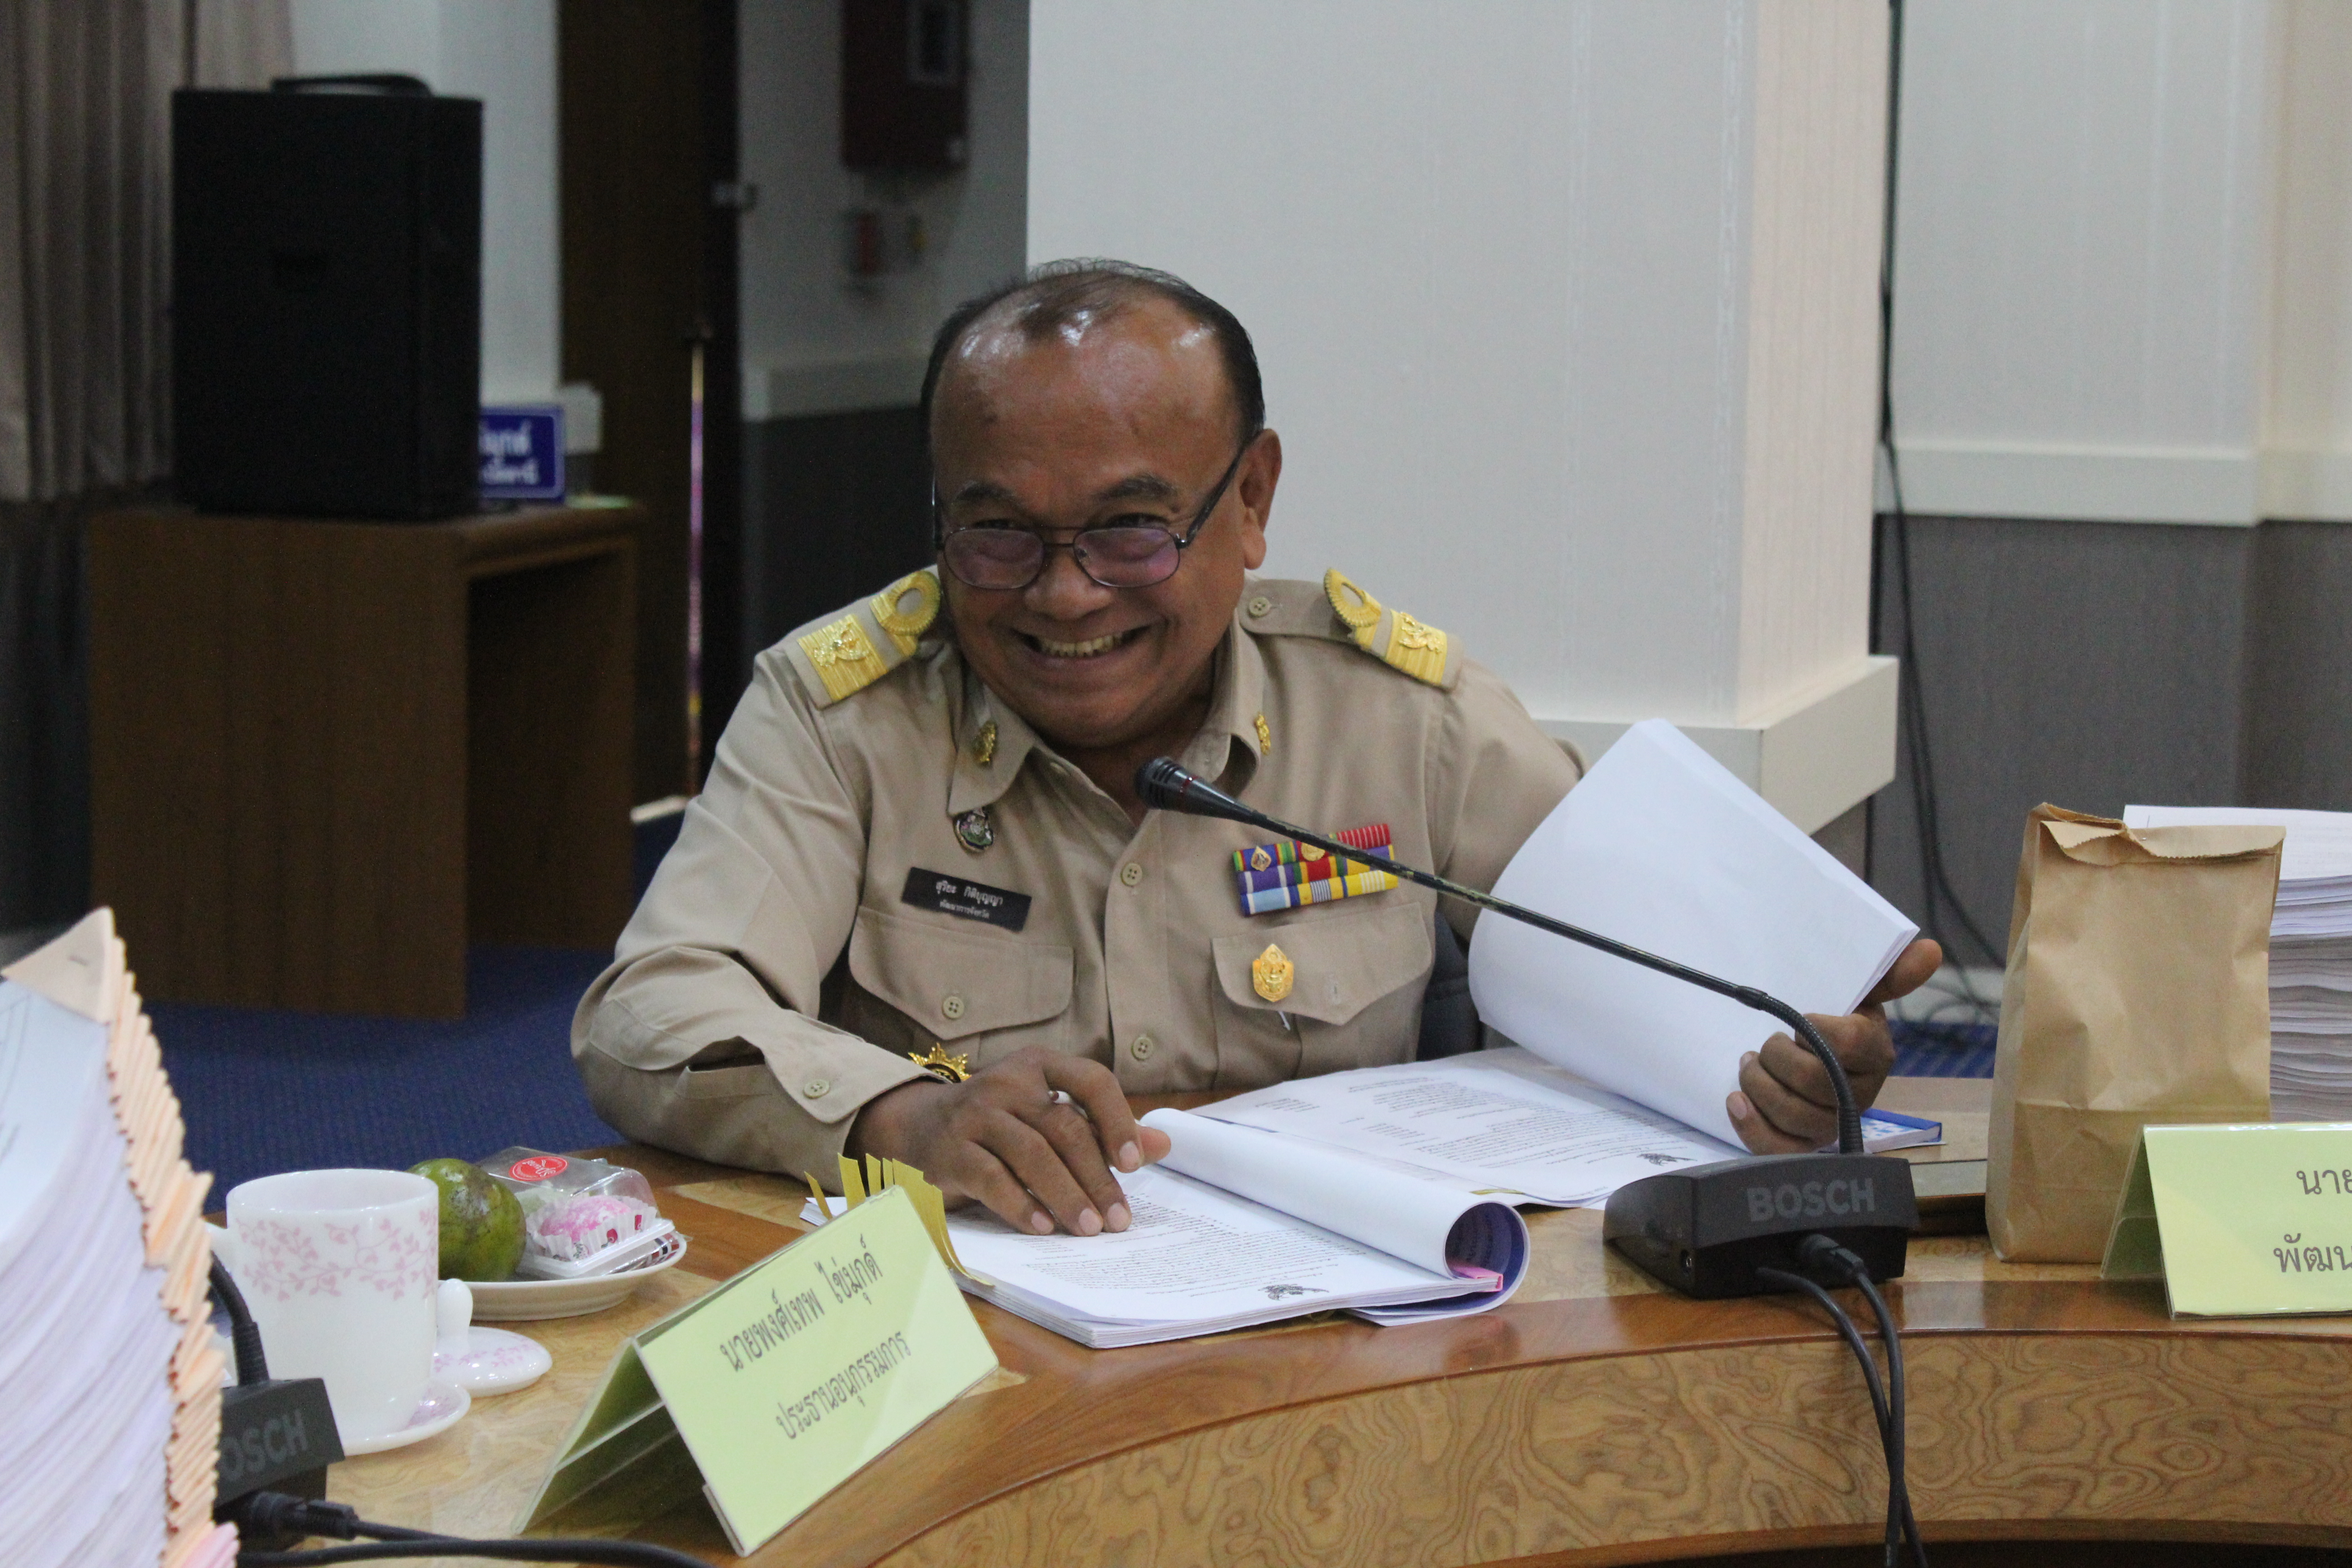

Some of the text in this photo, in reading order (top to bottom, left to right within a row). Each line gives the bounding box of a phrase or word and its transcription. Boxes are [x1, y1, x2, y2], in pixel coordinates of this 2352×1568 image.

[1747, 1178, 1875, 1222] BOSCH
[720, 1233, 883, 1372] นายพงศ์เทพ ไข่มุกด์
[775, 1331, 911, 1439] ประธานอนุกรรมการ
[219, 1408, 308, 1481] OSCH
